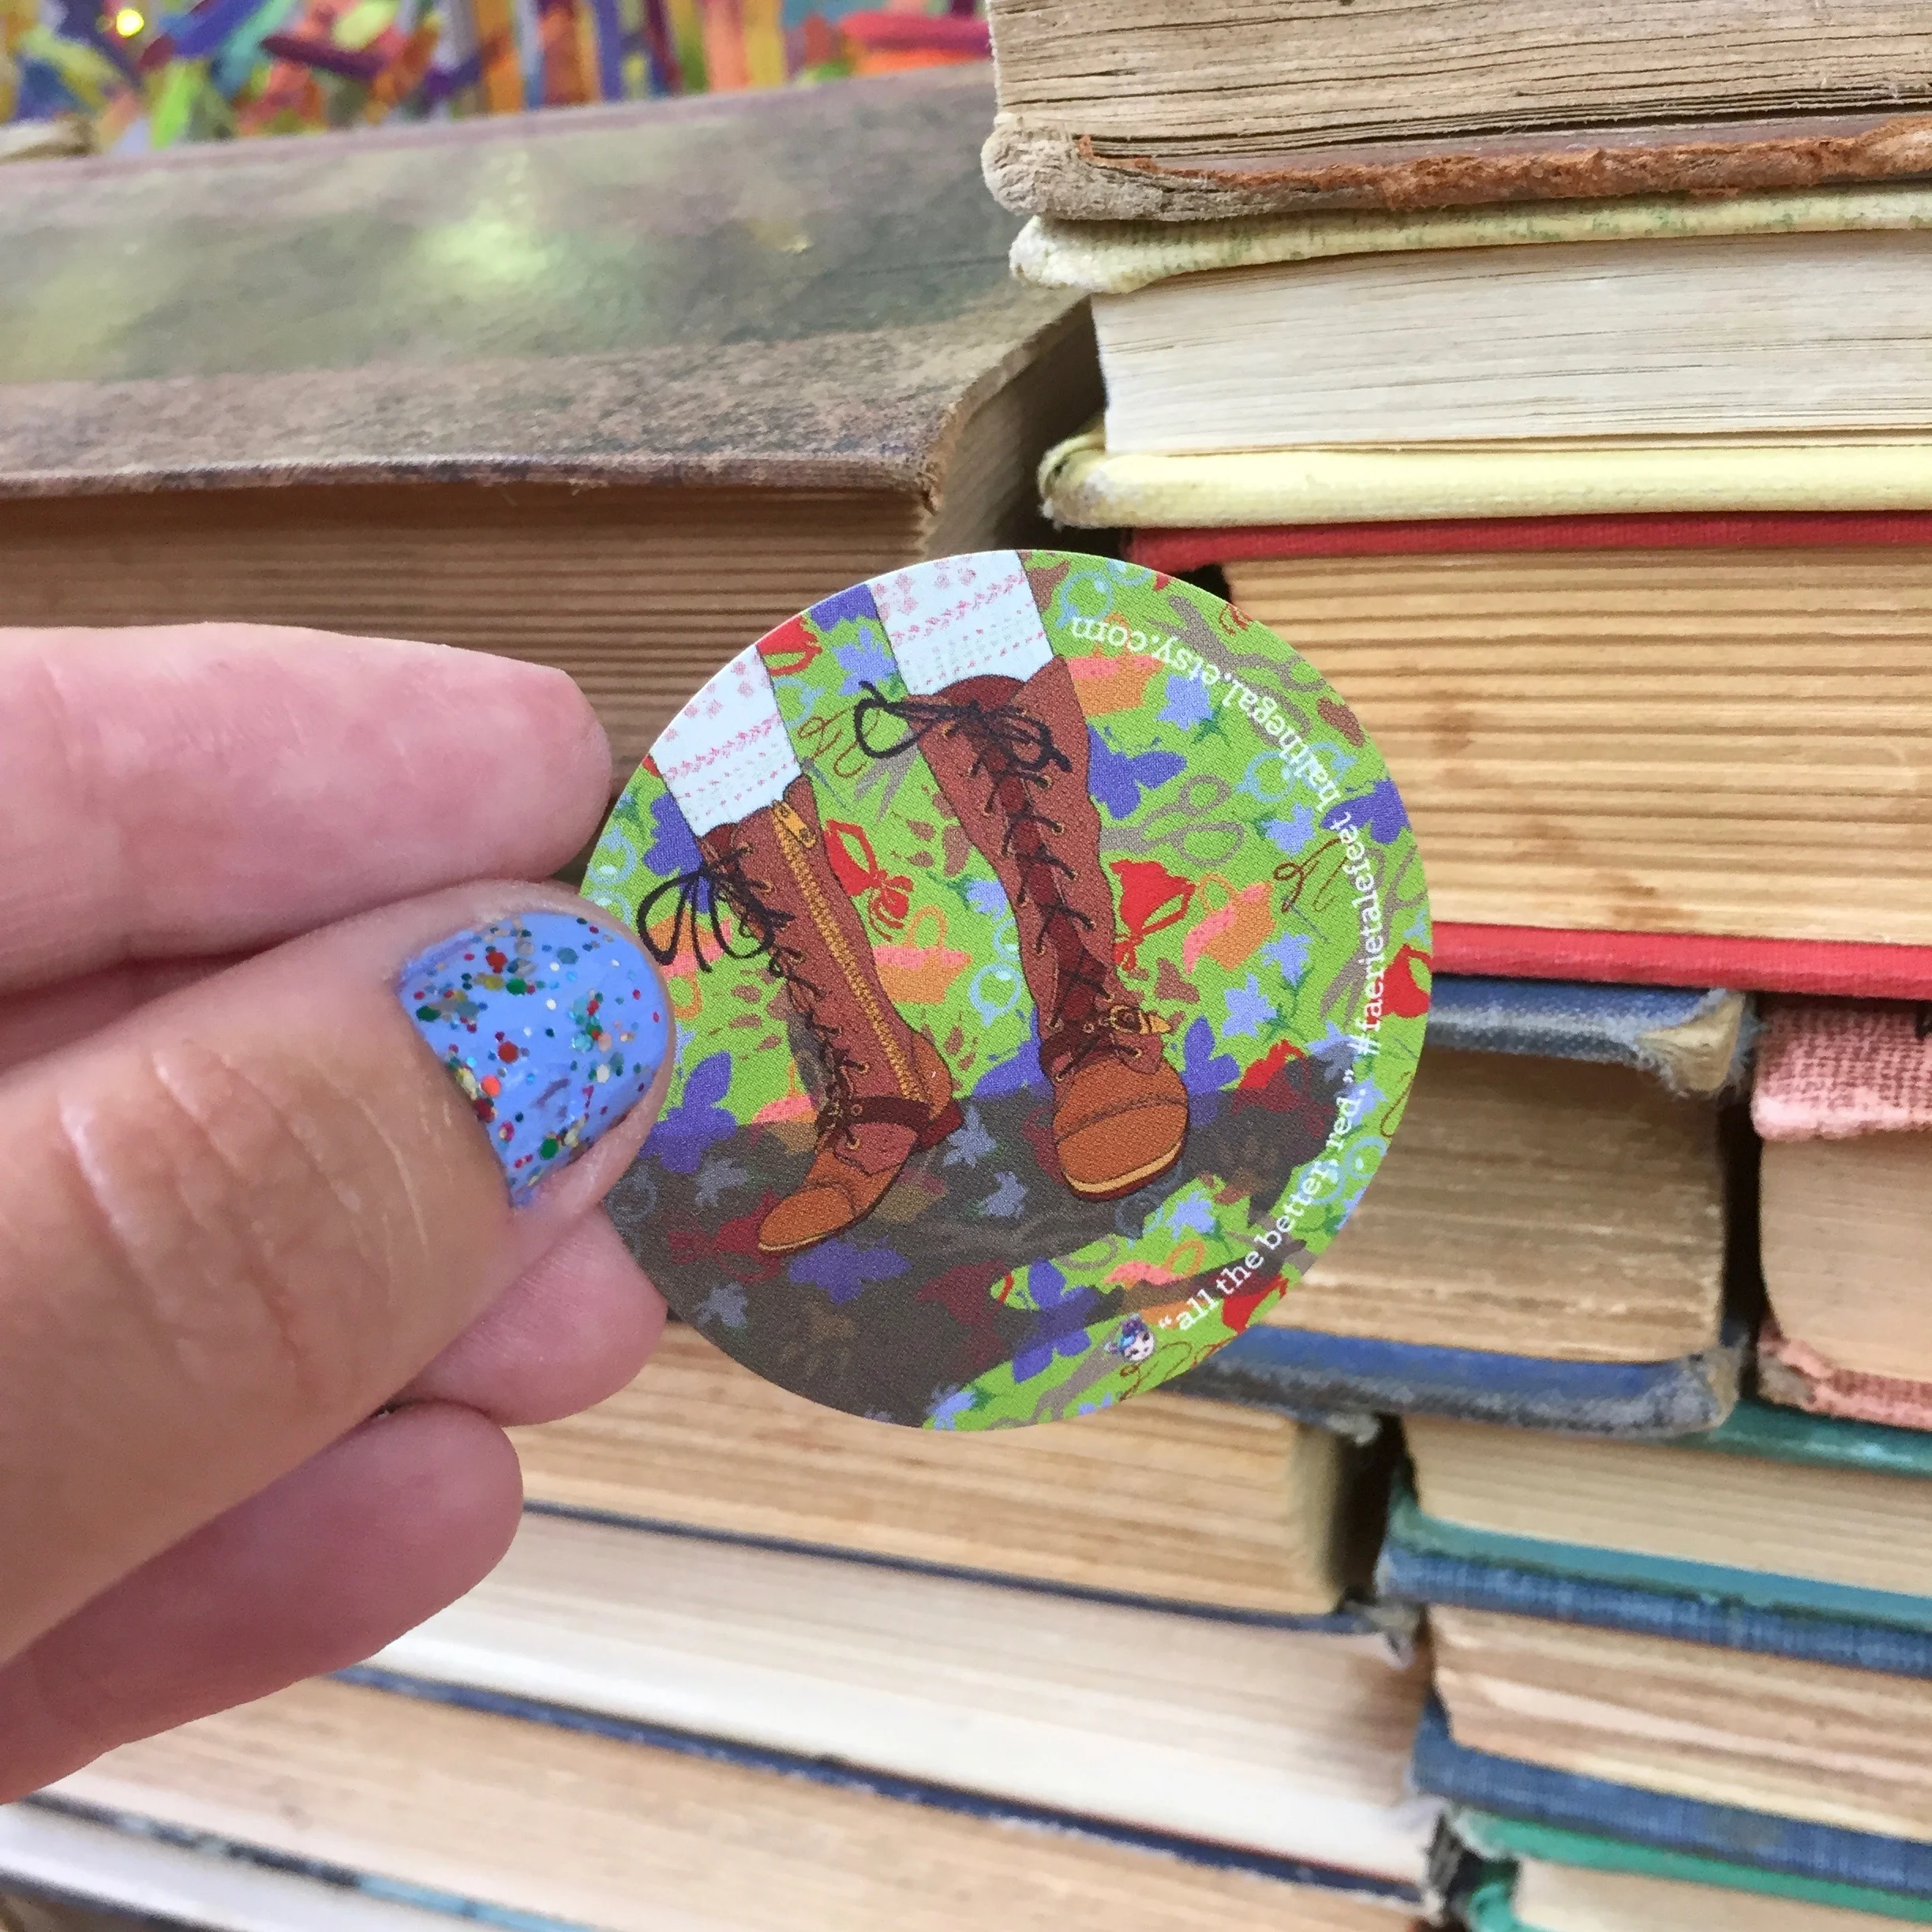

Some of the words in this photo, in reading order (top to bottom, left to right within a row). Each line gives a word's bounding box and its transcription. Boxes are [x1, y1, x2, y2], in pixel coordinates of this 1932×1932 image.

[1069, 616, 1341, 811] halthegal.etsy.com
[1329, 811, 1386, 1056] #faerietalefeet
[1325, 1069, 1366, 1152] red.”
[1253, 1159, 1339, 1251] better,
[1157, 1288, 1219, 1331] “all
[1215, 1249, 1265, 1295] the
